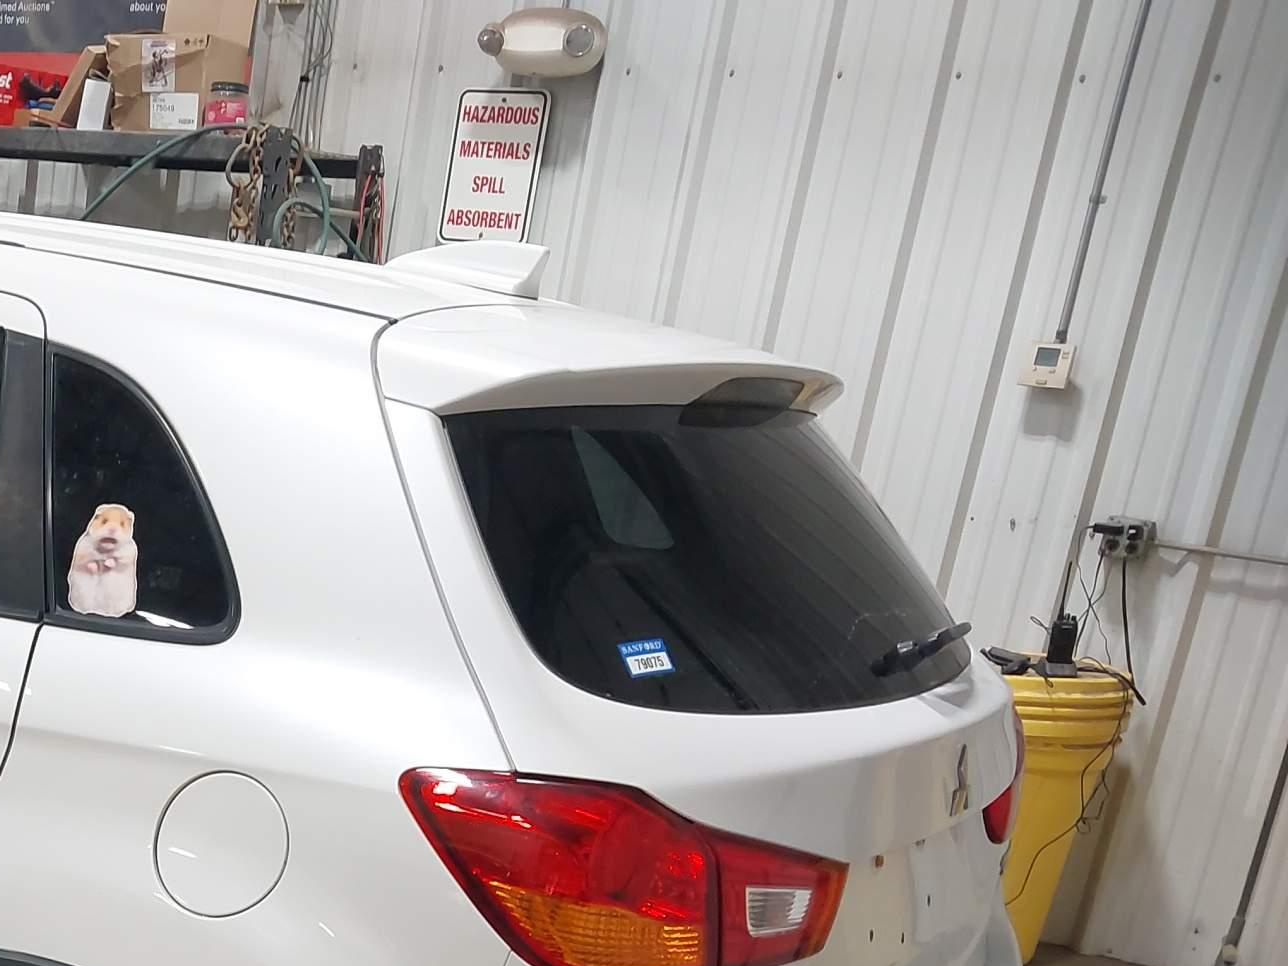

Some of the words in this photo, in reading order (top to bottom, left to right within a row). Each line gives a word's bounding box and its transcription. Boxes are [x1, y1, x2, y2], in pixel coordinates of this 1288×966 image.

[129, 1, 154, 12] about
[4, 14, 14, 24] for
[15, 15, 30, 26] you
[462, 105, 540, 125] HAZARDOUS
[459, 140, 532, 160] MATERIALS
[472, 176, 506, 194] SPILL
[447, 209, 522, 230] ABSORBENT
[633, 655, 665, 671] 79075
